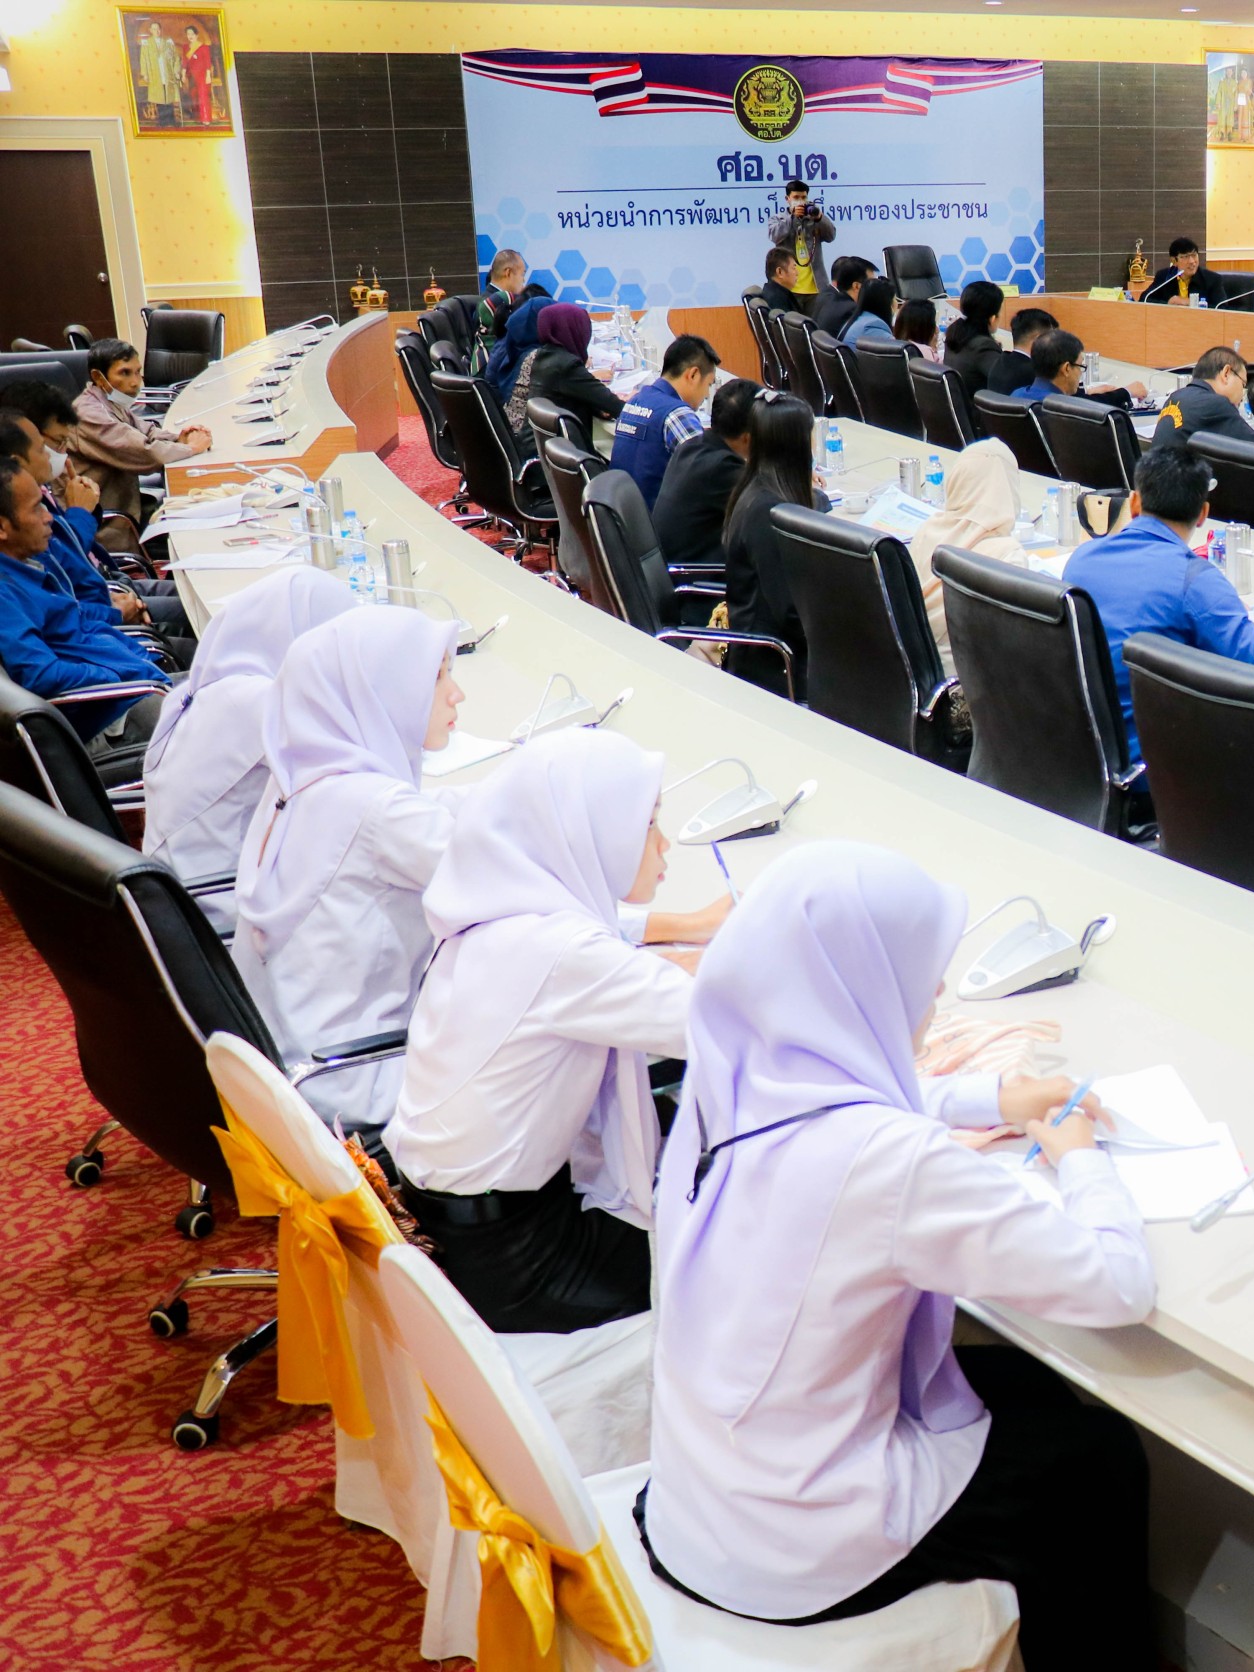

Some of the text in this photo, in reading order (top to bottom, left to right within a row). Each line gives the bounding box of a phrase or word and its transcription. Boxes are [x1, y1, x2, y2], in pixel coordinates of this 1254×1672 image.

[716, 151, 838, 182] ศอ.บต.
[557, 198, 751, 229] หน่วยนำการพัฒนา
